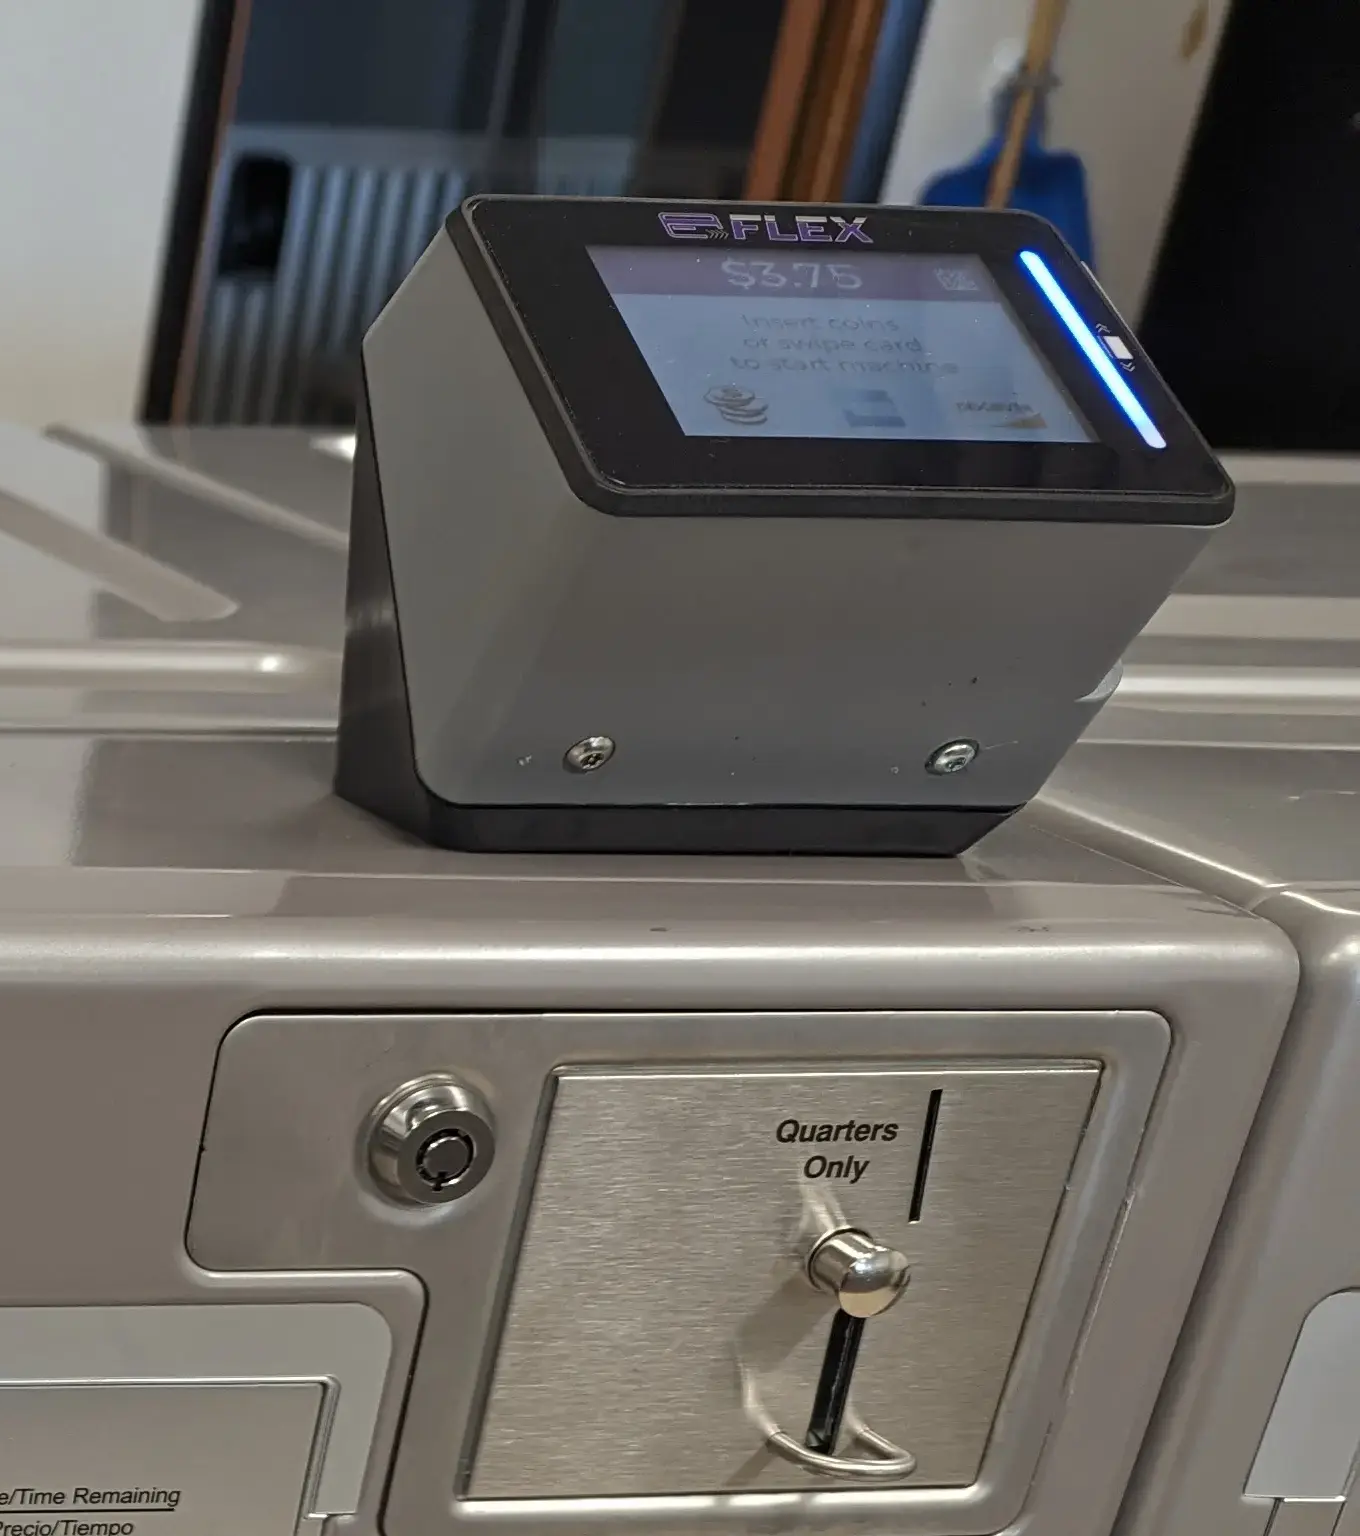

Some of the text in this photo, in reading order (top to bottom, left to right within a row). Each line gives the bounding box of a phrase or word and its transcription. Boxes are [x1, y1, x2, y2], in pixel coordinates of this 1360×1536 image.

[730, 214, 874, 243] FLEX
[721, 256, 863, 290] $3.75
[775, 1118, 899, 1143] Quarters
[803, 1155, 870, 1184] Only
[72, 1487, 181, 1507] Remaining
